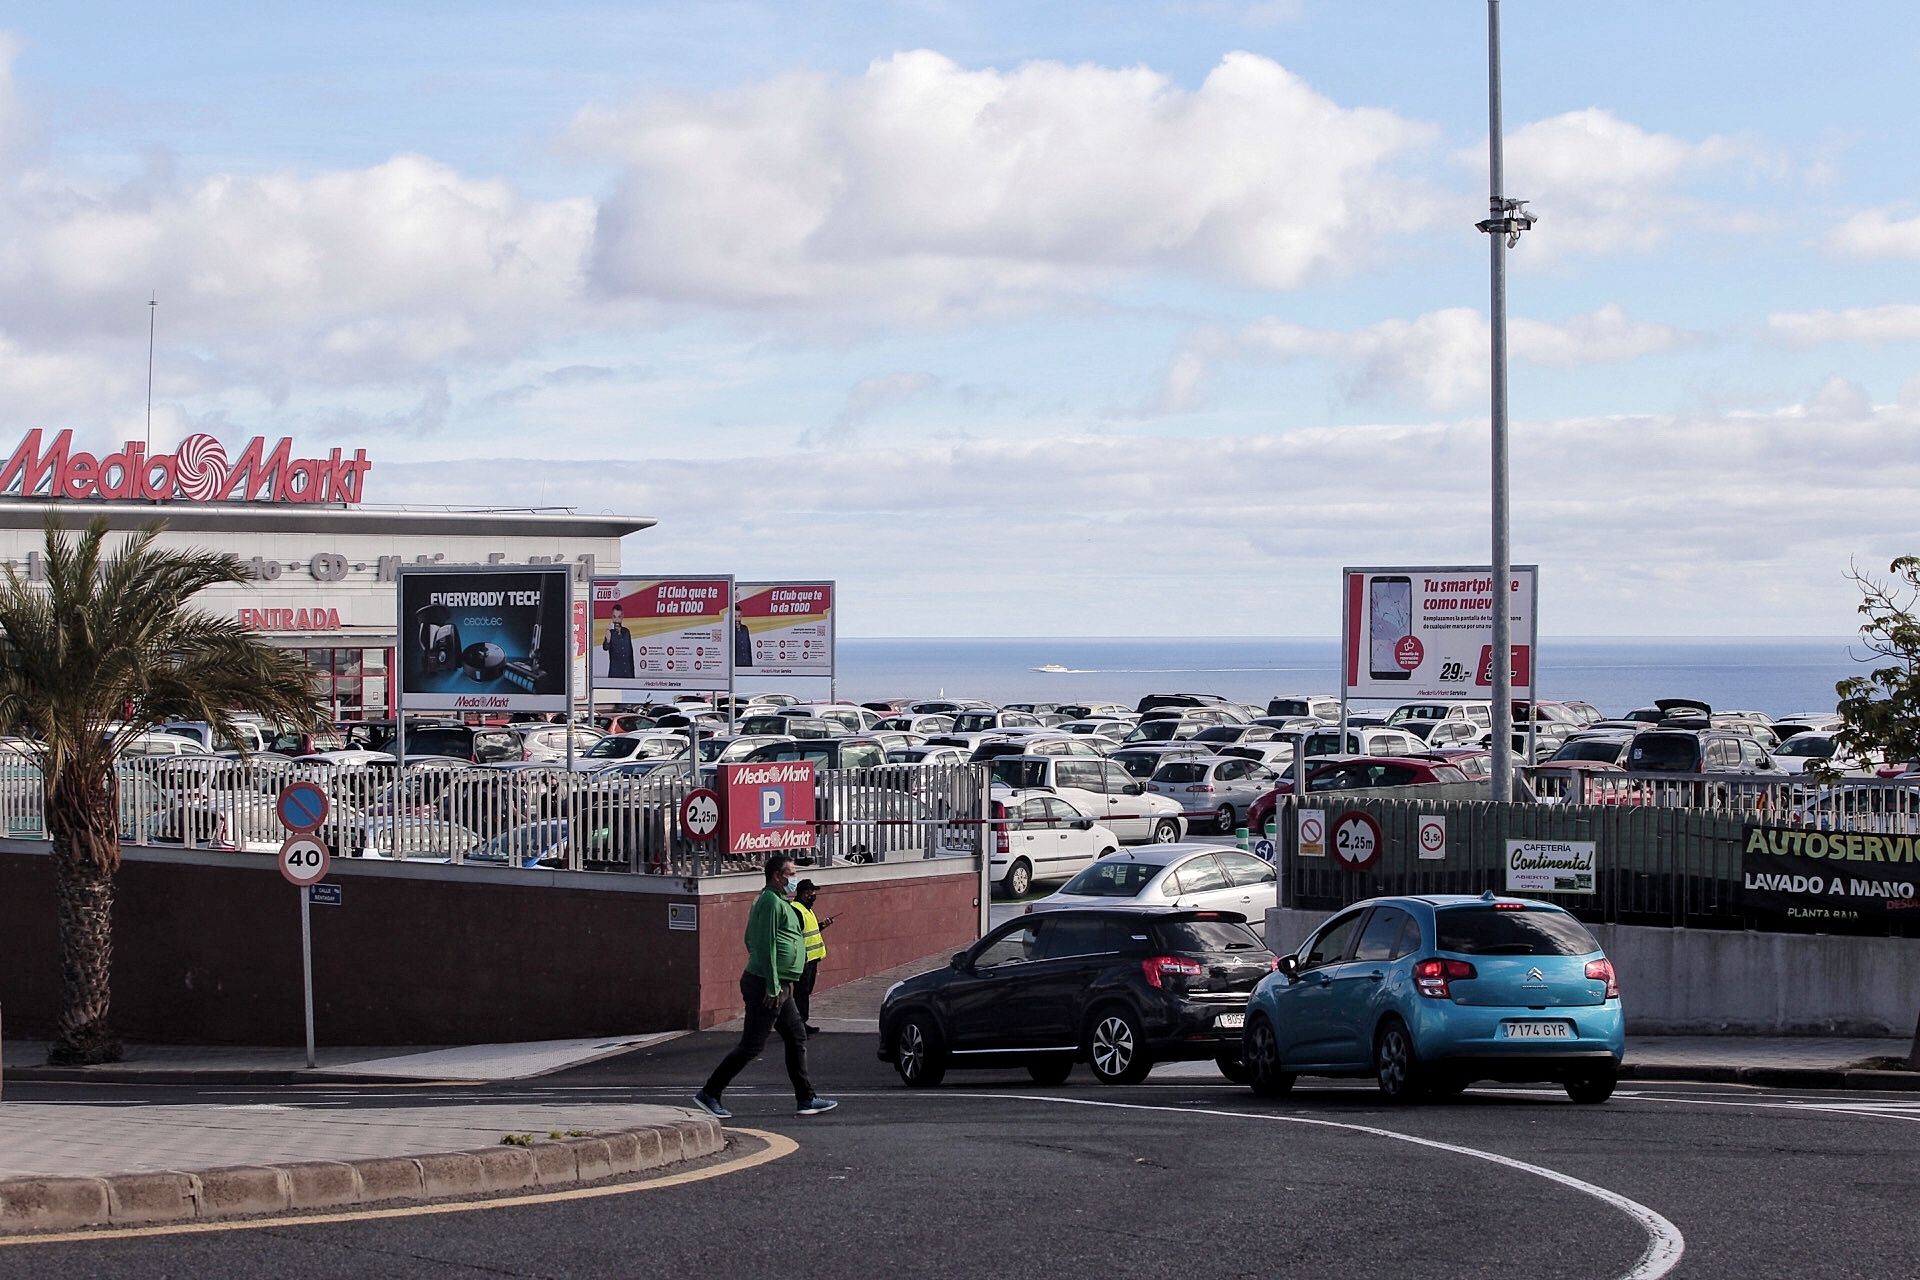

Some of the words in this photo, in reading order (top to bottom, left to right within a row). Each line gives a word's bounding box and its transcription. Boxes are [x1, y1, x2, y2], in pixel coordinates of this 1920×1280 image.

[1424, 579, 1439, 592] Tu
[1440, 578, 1519, 594] smartphe
[430, 592, 505, 606] EVERYBODY
[507, 591, 540, 606] TECH
[597, 591, 611, 599] CLUB
[658, 587, 667, 598] El
[667, 586, 688, 598] Club
[688, 589, 707, 601] que
[708, 587, 718, 598] te
[772, 591, 779, 600] El
[779, 590, 796, 600] Club
[797, 592, 813, 602] que
[814, 591, 822, 600] te
[656, 601, 667, 613] lo
[667, 601, 679, 613] da
[680, 601, 704, 613] TODO
[770, 603, 778, 613] lo
[779, 603, 789, 613] da
[790, 603, 810, 613] TODO
[1424, 598, 1458, 610] como
[1460, 598, 1492, 610] nuev
[238, 608, 342, 631] ENTRADA
[464, 617, 502, 625] cecotec
[763, 791, 781, 823] P
[1524, 843, 1571, 852] CAFETERÍA
[288, 850, 320, 866] 40
[1510, 848, 1593, 870] Continental
[1745, 872, 1824, 894] LAVADO
[1828, 877, 1845, 896] A
[1850, 878, 1914, 898] MANO
[1787, 907, 1830, 918] PLANTA
[1509, 1025, 1540, 1036] 7174
[1543, 1025, 1566, 1036] GYR
